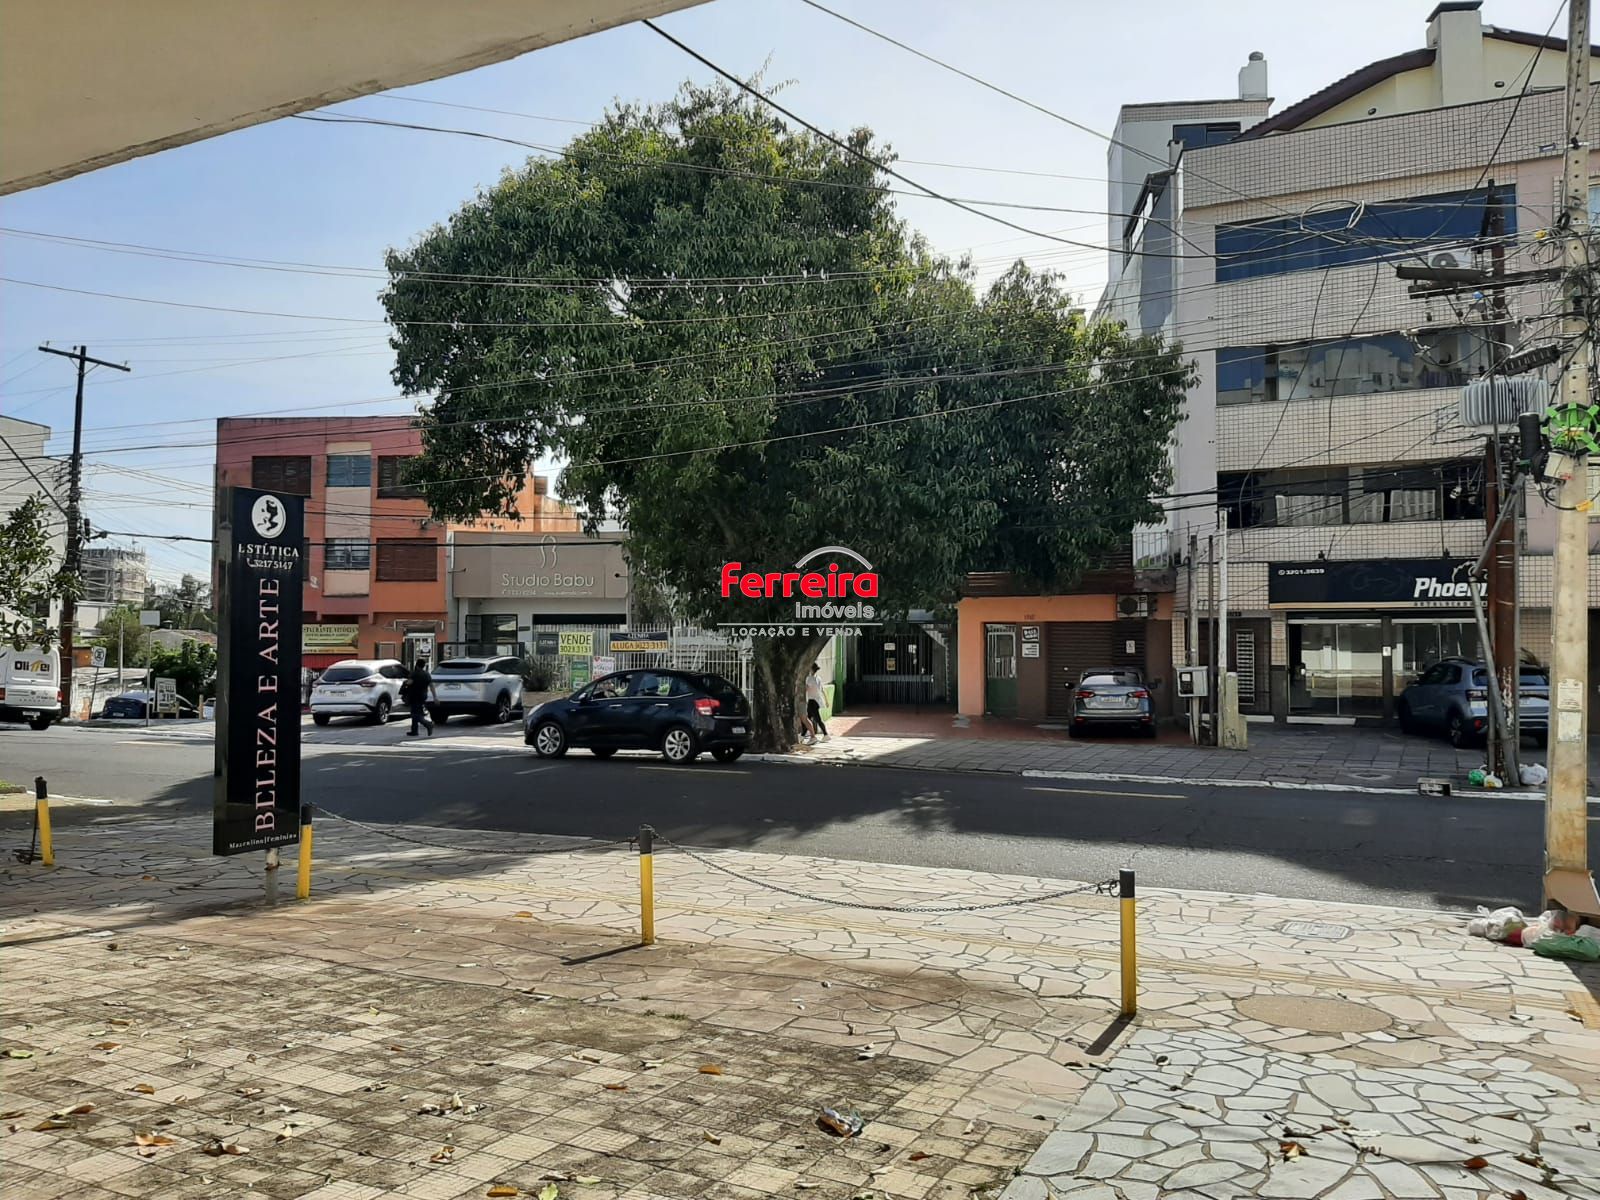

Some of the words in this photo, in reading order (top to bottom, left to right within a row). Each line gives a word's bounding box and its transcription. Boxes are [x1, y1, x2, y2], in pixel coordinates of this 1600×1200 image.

[502, 573, 550, 587] Studio
[554, 573, 594, 587] Babu
[258, 578, 279, 664] ARTE
[560, 634, 592, 645] VENDE
[258, 675, 278, 693] E
